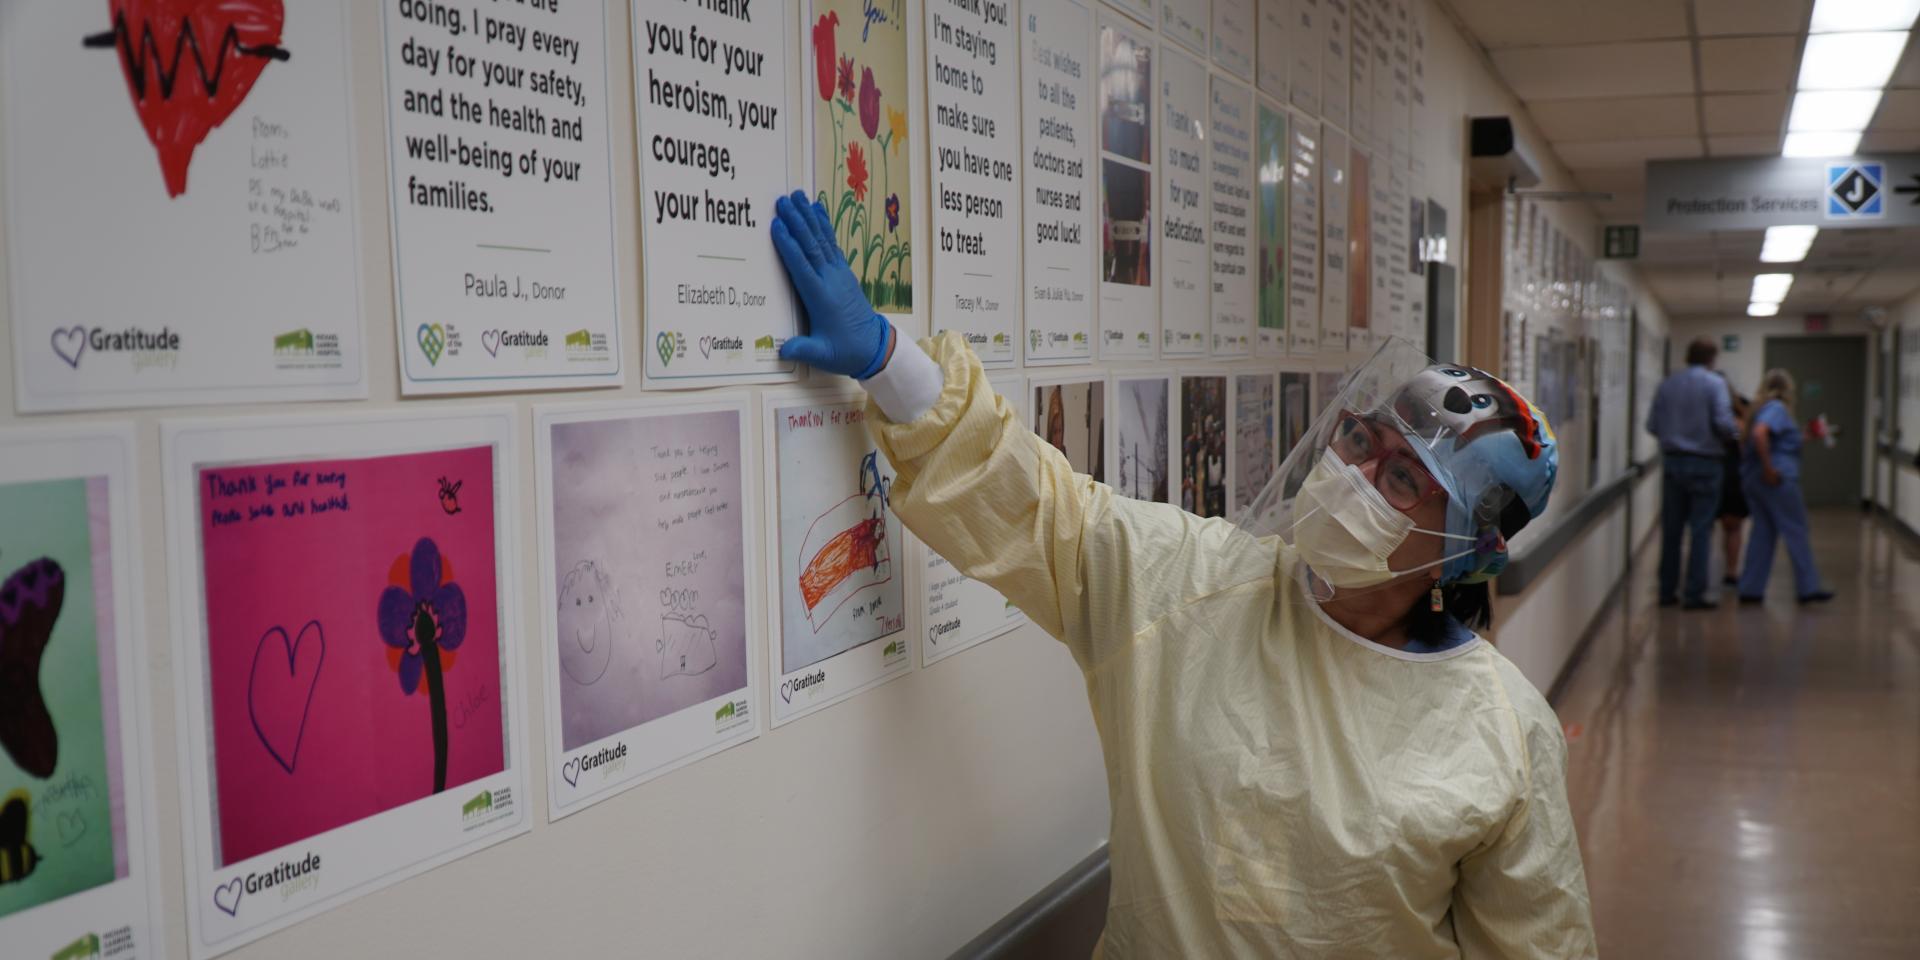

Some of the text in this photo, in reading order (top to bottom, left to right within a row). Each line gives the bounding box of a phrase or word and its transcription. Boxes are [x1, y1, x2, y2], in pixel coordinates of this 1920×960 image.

[694, 0, 751, 22] ank
[984, 1, 1008, 26] you!
[400, 0, 579, 64] doing. I pray every
[934, 13, 996, 65] I'm staying
[646, 20, 763, 76] you for your
[402, 37, 586, 107] day for your safety,
[935, 55, 984, 95] home to
[1054, 51, 1081, 79] wishes
[649, 68, 777, 130] heroism, your
[1038, 78, 1075, 110] to all the
[404, 89, 582, 142] and the health and
[937, 103, 996, 139] make sure
[1166, 104, 1189, 133] Thank
[1040, 116, 1076, 149] patients,
[406, 134, 581, 182] well-being of your
[652, 134, 735, 180] courage,
[938, 145, 1012, 182] you have one
[1033, 146, 1082, 179] doctors and
[1169, 148, 1200, 173] so much
[408, 176, 493, 213] families.
[655, 189, 756, 227] your heart.
[940, 182, 1003, 219] less person
[1036, 187, 1080, 211] nurses and
[1169, 180, 1199, 210] for your
[1667, 175, 1865, 215] Protection Services J
[941, 227, 986, 256] to treat.
[1037, 220, 1081, 245] good luck!
[1164, 215, 1205, 244] dedication.
[464, 273, 565, 301] Paula J., Donor
[677, 284, 726, 304] Elizabeth
[743, 291, 766, 306] Donor
[955, 294, 975, 312] Tracey
[89, 327, 179, 350] Gratitude
[501, 330, 549, 347] Gratitude
[711, 336, 743, 351] Gratitude
[207, 473, 256, 498] Thank
[264, 473, 286, 495] you
[938, 617, 961, 636] Gratitude
[793, 669, 825, 692] Gratitude
[581, 741, 627, 773] Gratitude
[245, 852, 320, 895] Gratitude
[280, 872, 320, 902] gallery
